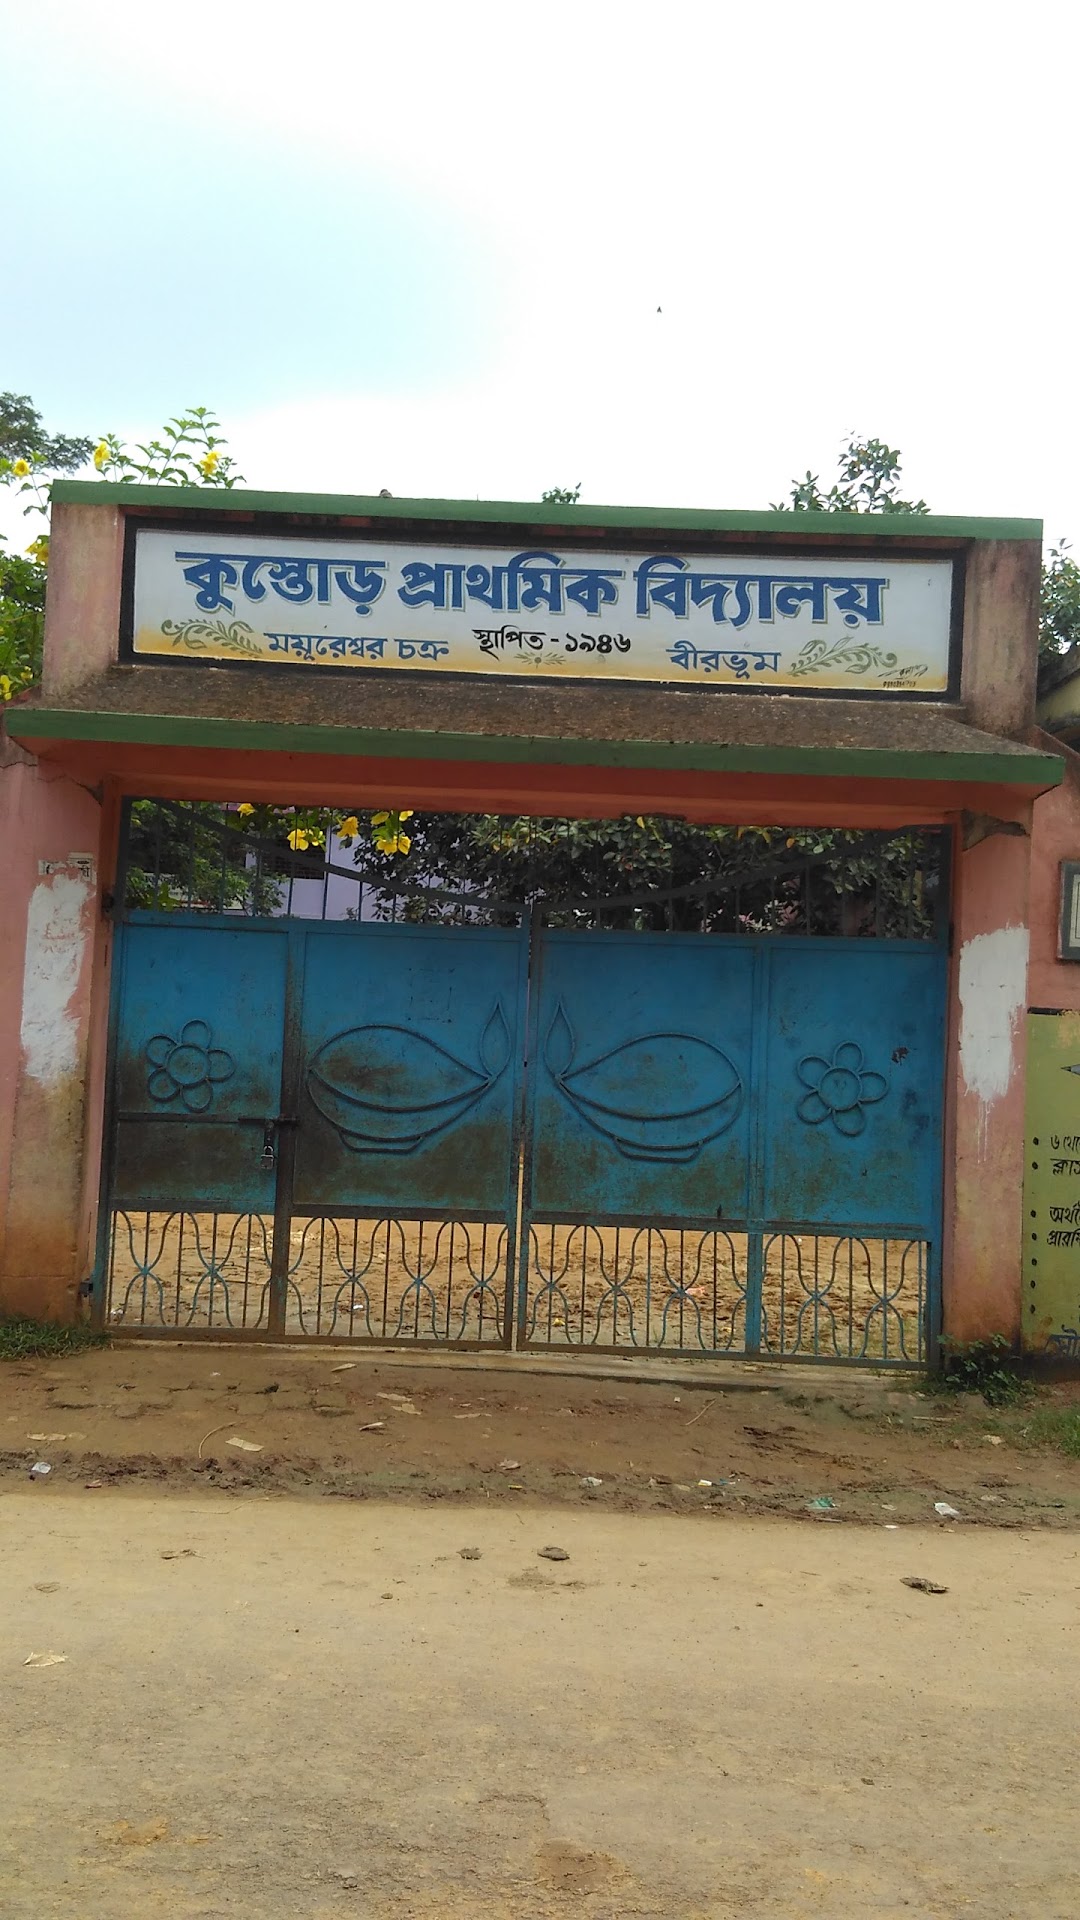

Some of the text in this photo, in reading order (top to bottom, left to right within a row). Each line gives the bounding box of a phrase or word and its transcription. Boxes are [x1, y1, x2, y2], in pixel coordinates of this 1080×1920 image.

[174, 550, 888, 628] কুস্তোড় প্রাথমিক বিদ্যালয়
[262, 631, 449, 661] ময়ূরেশ্বর চক্র
[666, 639, 782, 679] বীরভূম
